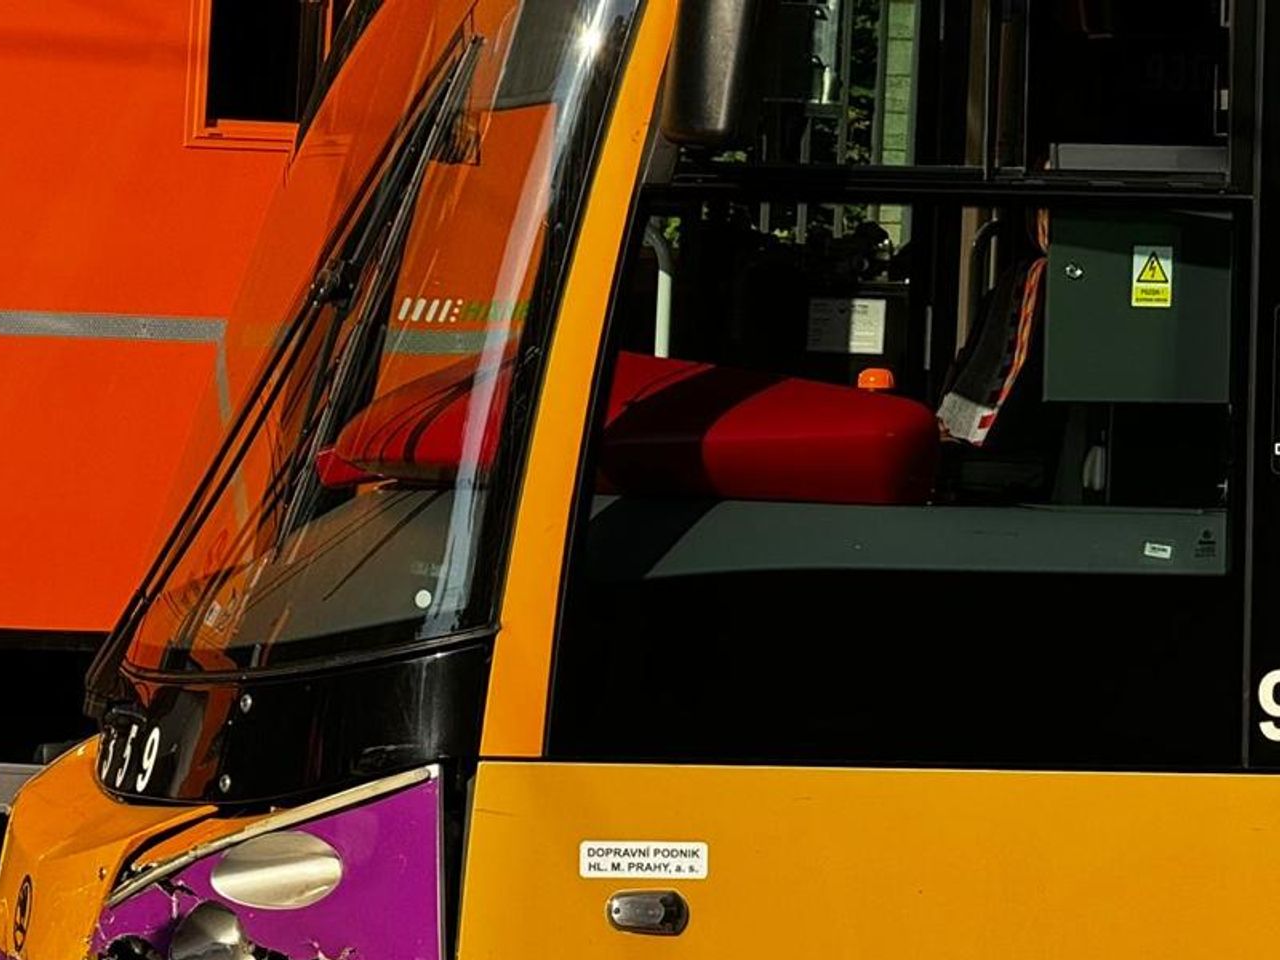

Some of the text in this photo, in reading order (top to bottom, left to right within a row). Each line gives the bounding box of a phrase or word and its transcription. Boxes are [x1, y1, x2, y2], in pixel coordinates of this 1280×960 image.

[587, 846, 700, 859] DOPRAVNÍ PODNIK
[588, 862, 608, 872] HL.
[611, 862, 624, 872] M.
[627, 863, 672, 874] PRAHY,
